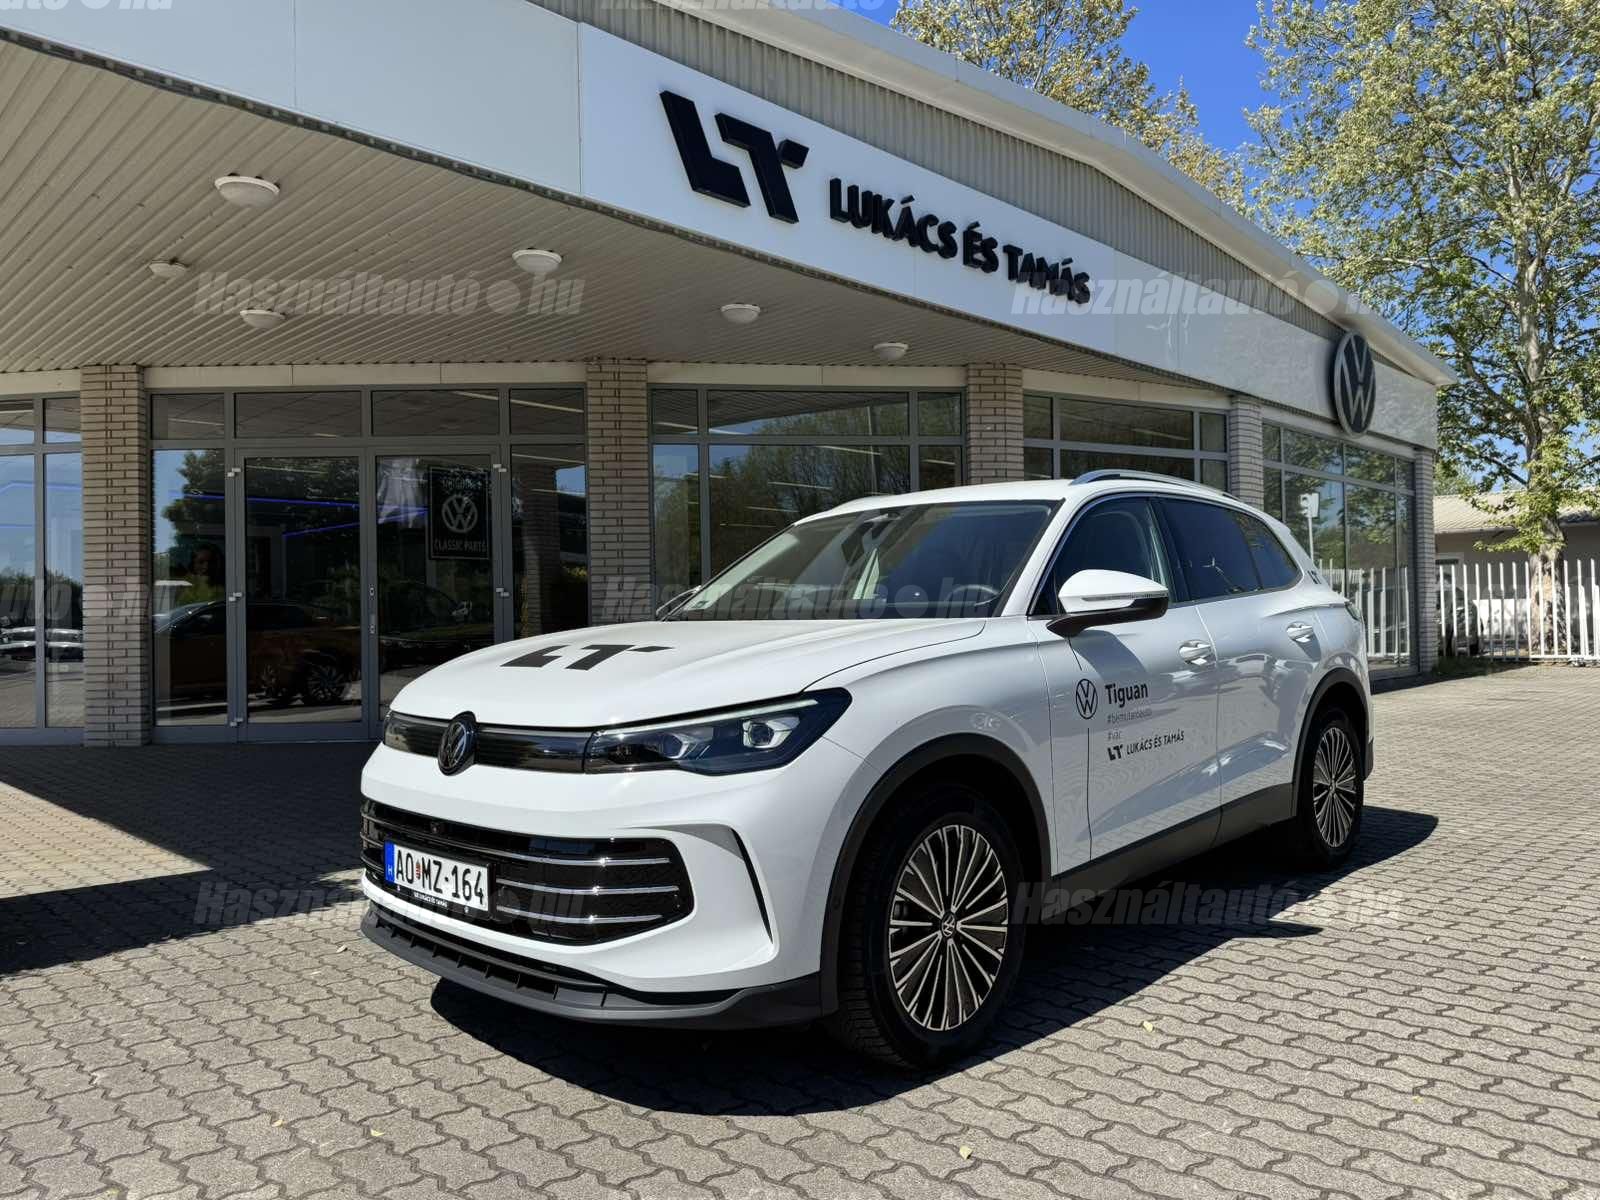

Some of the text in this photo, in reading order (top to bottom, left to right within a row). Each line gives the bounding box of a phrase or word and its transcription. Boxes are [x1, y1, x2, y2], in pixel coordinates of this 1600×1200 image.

[829, 177, 1091, 305] LUKÁCS ÉS TAMÁS
[1104, 683, 1149, 708] Tiguan
[1126, 728, 1185, 755] LUKÁCS ÉS TAMÁS
